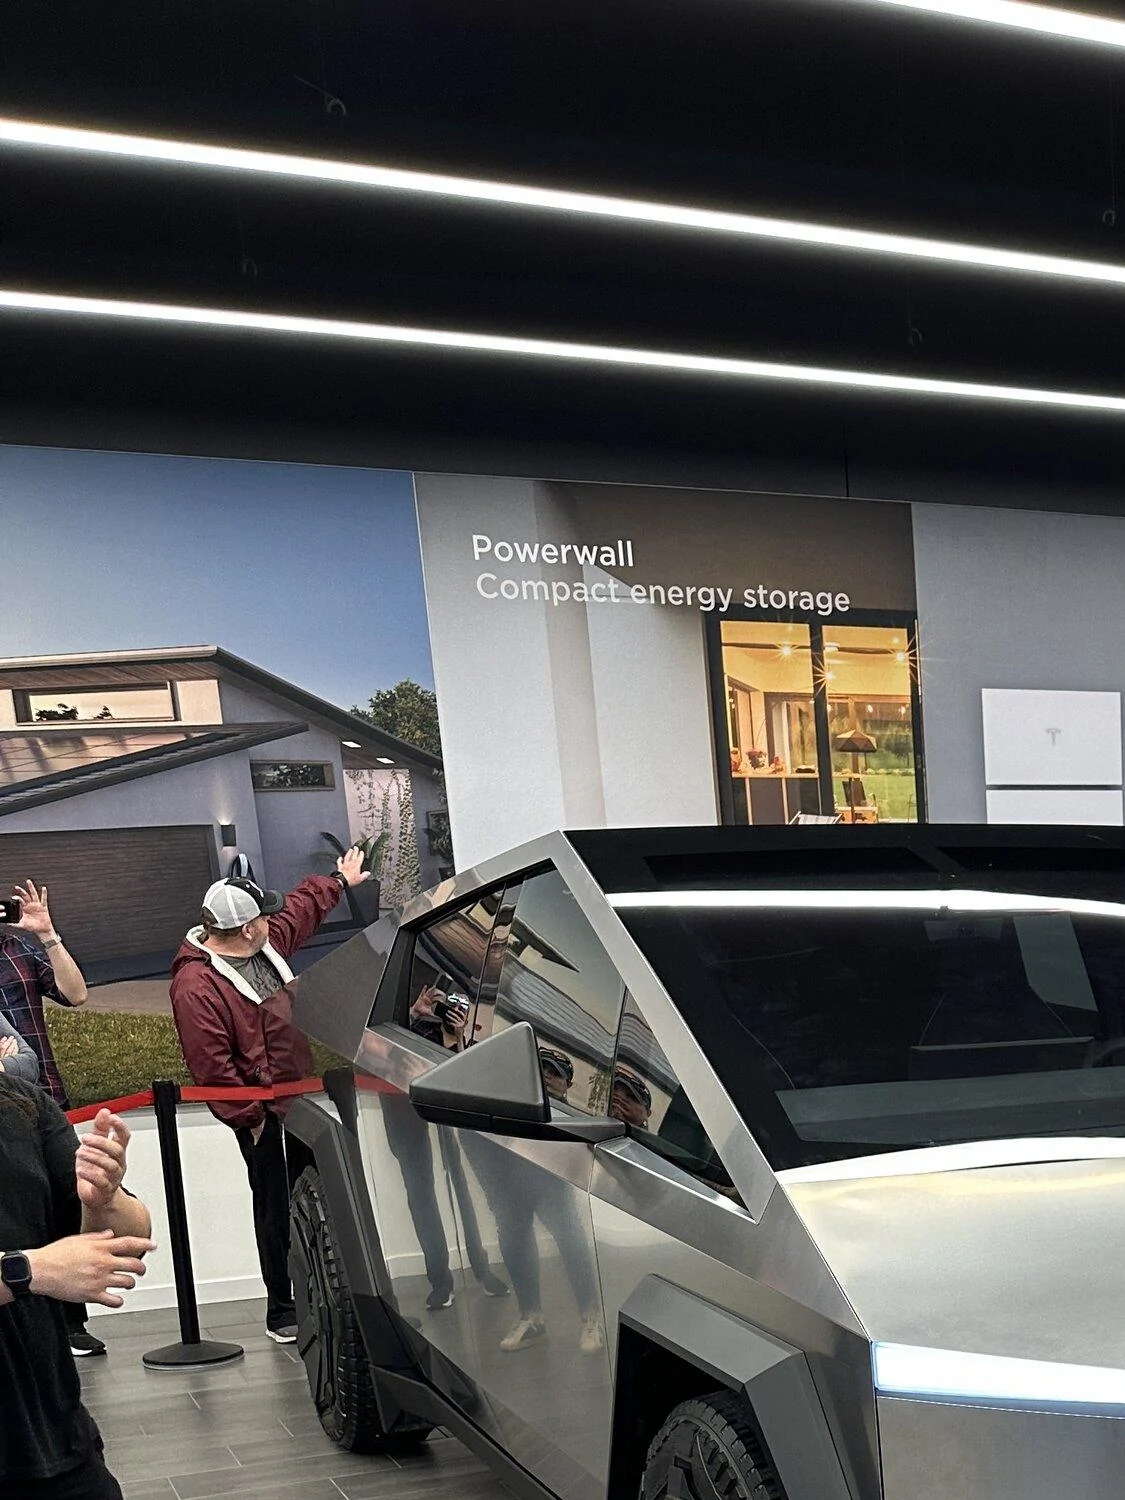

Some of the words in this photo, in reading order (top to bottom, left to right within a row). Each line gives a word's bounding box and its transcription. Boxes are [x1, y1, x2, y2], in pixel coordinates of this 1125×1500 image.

[472, 534, 634, 567] Powerwall
[476, 572, 618, 606] Compact
[630, 584, 733, 612] energy
[743, 584, 850, 615] storage
